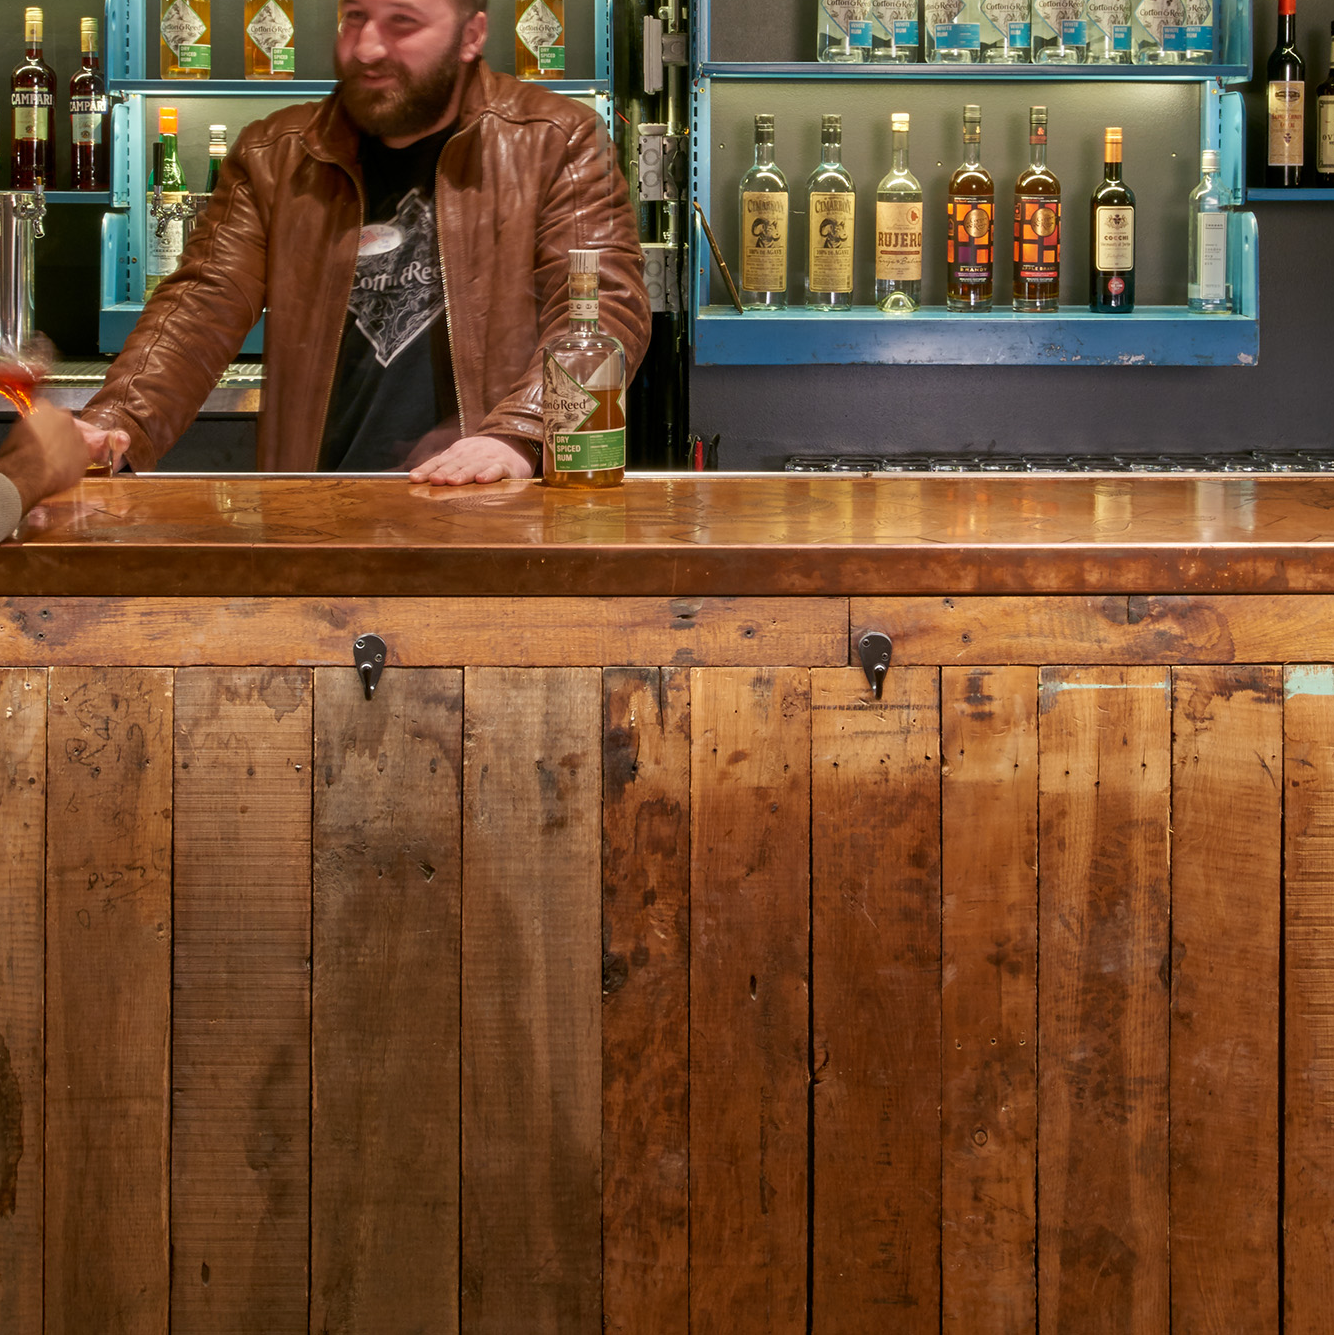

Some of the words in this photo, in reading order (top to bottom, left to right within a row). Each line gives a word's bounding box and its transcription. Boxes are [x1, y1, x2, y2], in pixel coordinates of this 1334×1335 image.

[11, 93, 53, 106] CAMPARI
[70, 95, 107, 112] CAMPARI
[556, 436, 570, 444] DRY
[556, 444, 581, 453] SPICED
[557, 453, 573, 462] RUM
